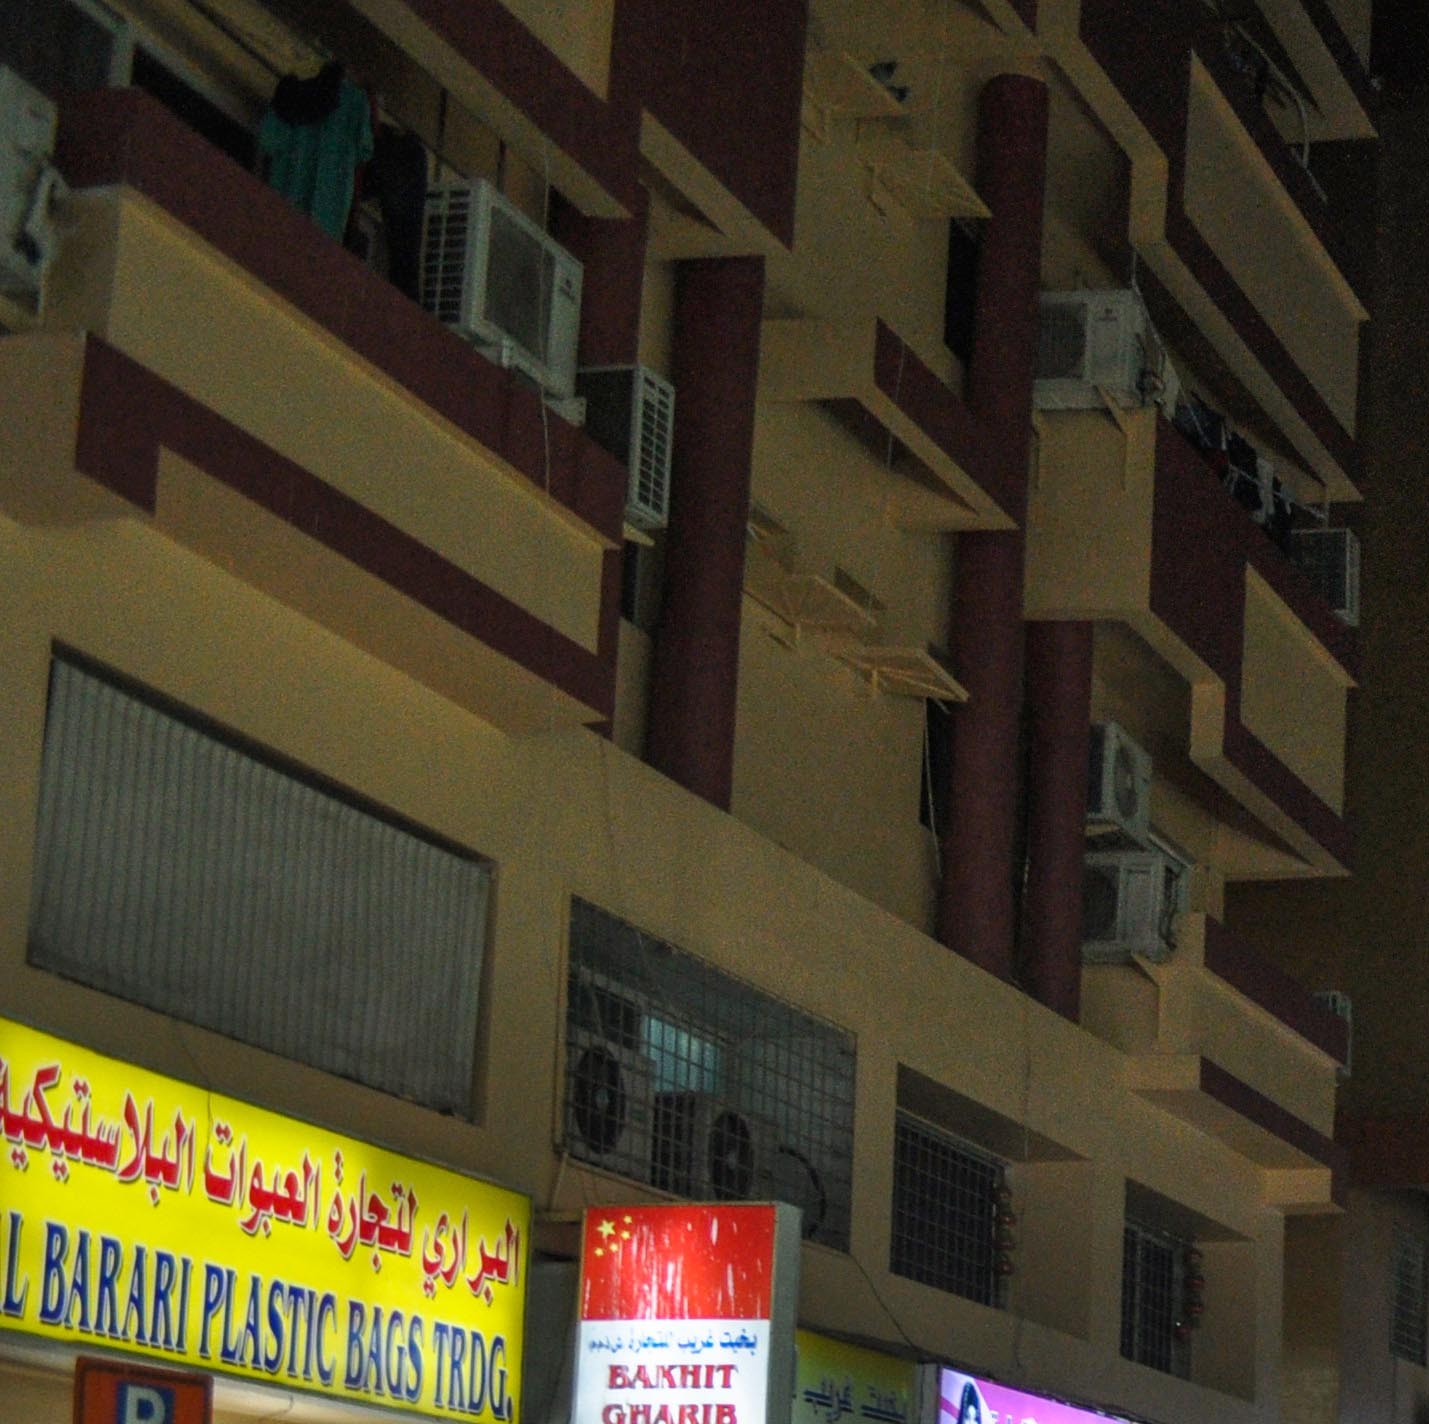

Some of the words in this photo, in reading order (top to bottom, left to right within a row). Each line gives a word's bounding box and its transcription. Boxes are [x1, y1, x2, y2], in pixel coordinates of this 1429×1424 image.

[203, 1121, 322, 1237] العبوات
[326, 1148, 418, 1274] لتجارة
[421, 1206, 520, 1306] البراري
[0, 1207, 29, 1320] L
[39, 1218, 193, 1359] BARARI
[197, 1260, 339, 1388] PLASTIC
[344, 1297, 425, 1404] BAGS
[432, 1318, 515, 1424] TRDG.
[607, 1363, 739, 1390] BAKHIT
